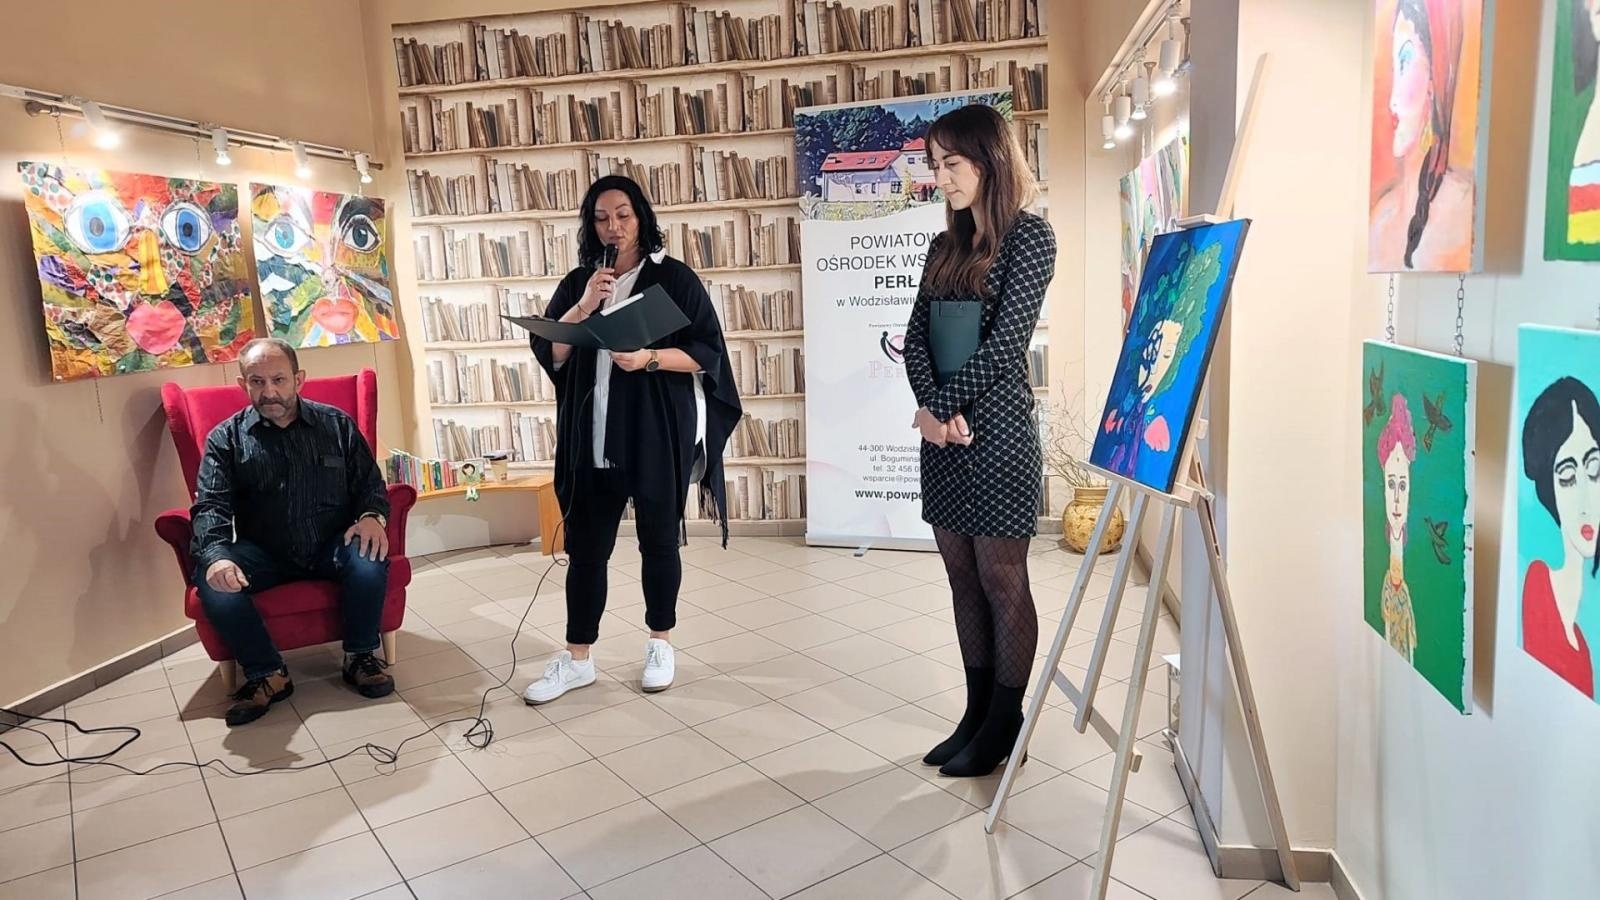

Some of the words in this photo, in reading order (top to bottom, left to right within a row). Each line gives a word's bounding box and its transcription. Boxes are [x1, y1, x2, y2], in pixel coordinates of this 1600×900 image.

[816, 254, 897, 272] OŚRODEK
[836, 298, 846, 307] w
[858, 444, 884, 452] 44-300
[886, 464, 897, 473] 32
[898, 465, 913, 473] 456
[862, 475, 921, 484] wsparcie@pow
